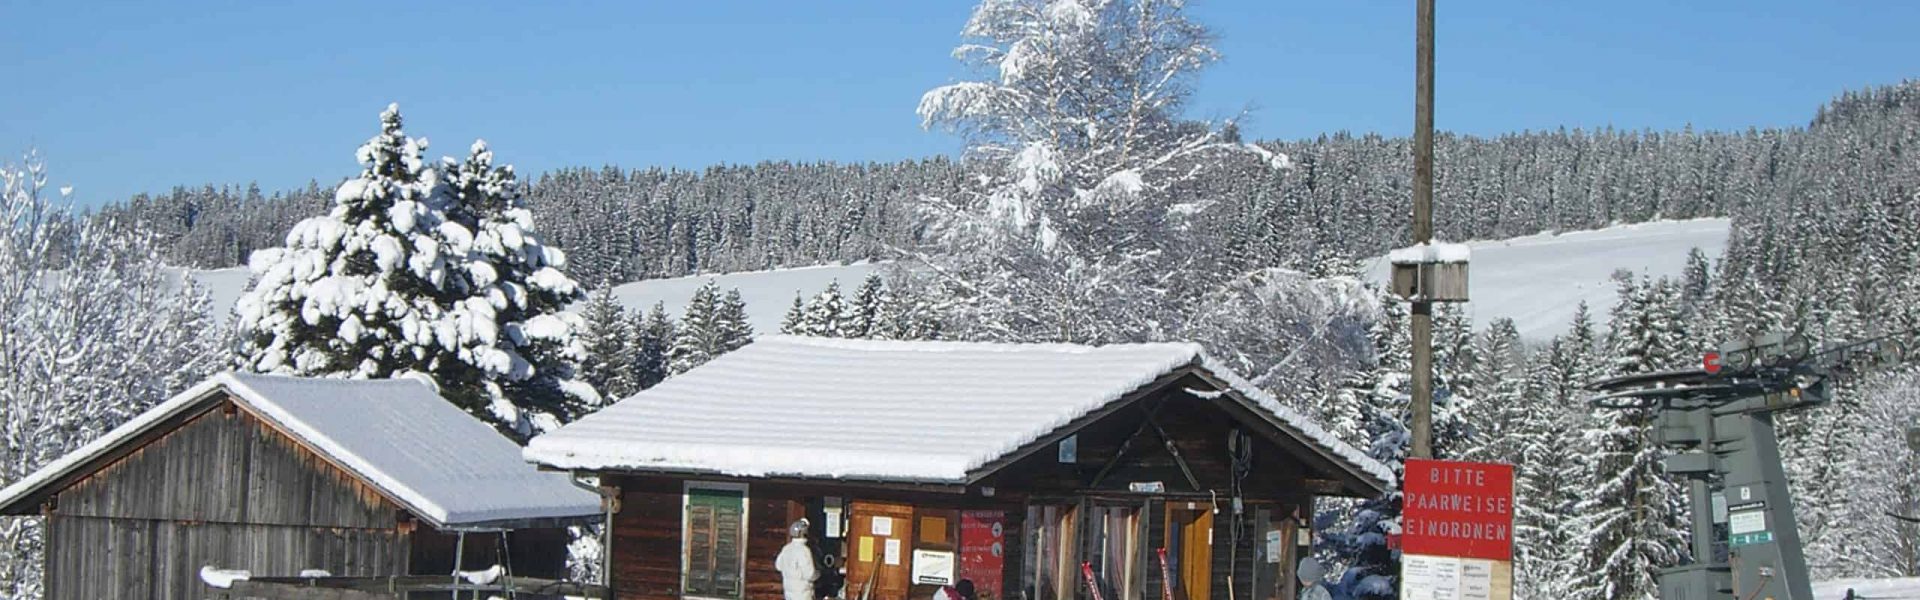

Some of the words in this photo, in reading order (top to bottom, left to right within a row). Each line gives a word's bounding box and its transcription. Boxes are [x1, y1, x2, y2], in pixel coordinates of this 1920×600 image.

[1430, 467, 1485, 486] BITTE
[1406, 493, 1507, 514] PAARWEISE
[1406, 519, 1506, 541] EINORDNEN
